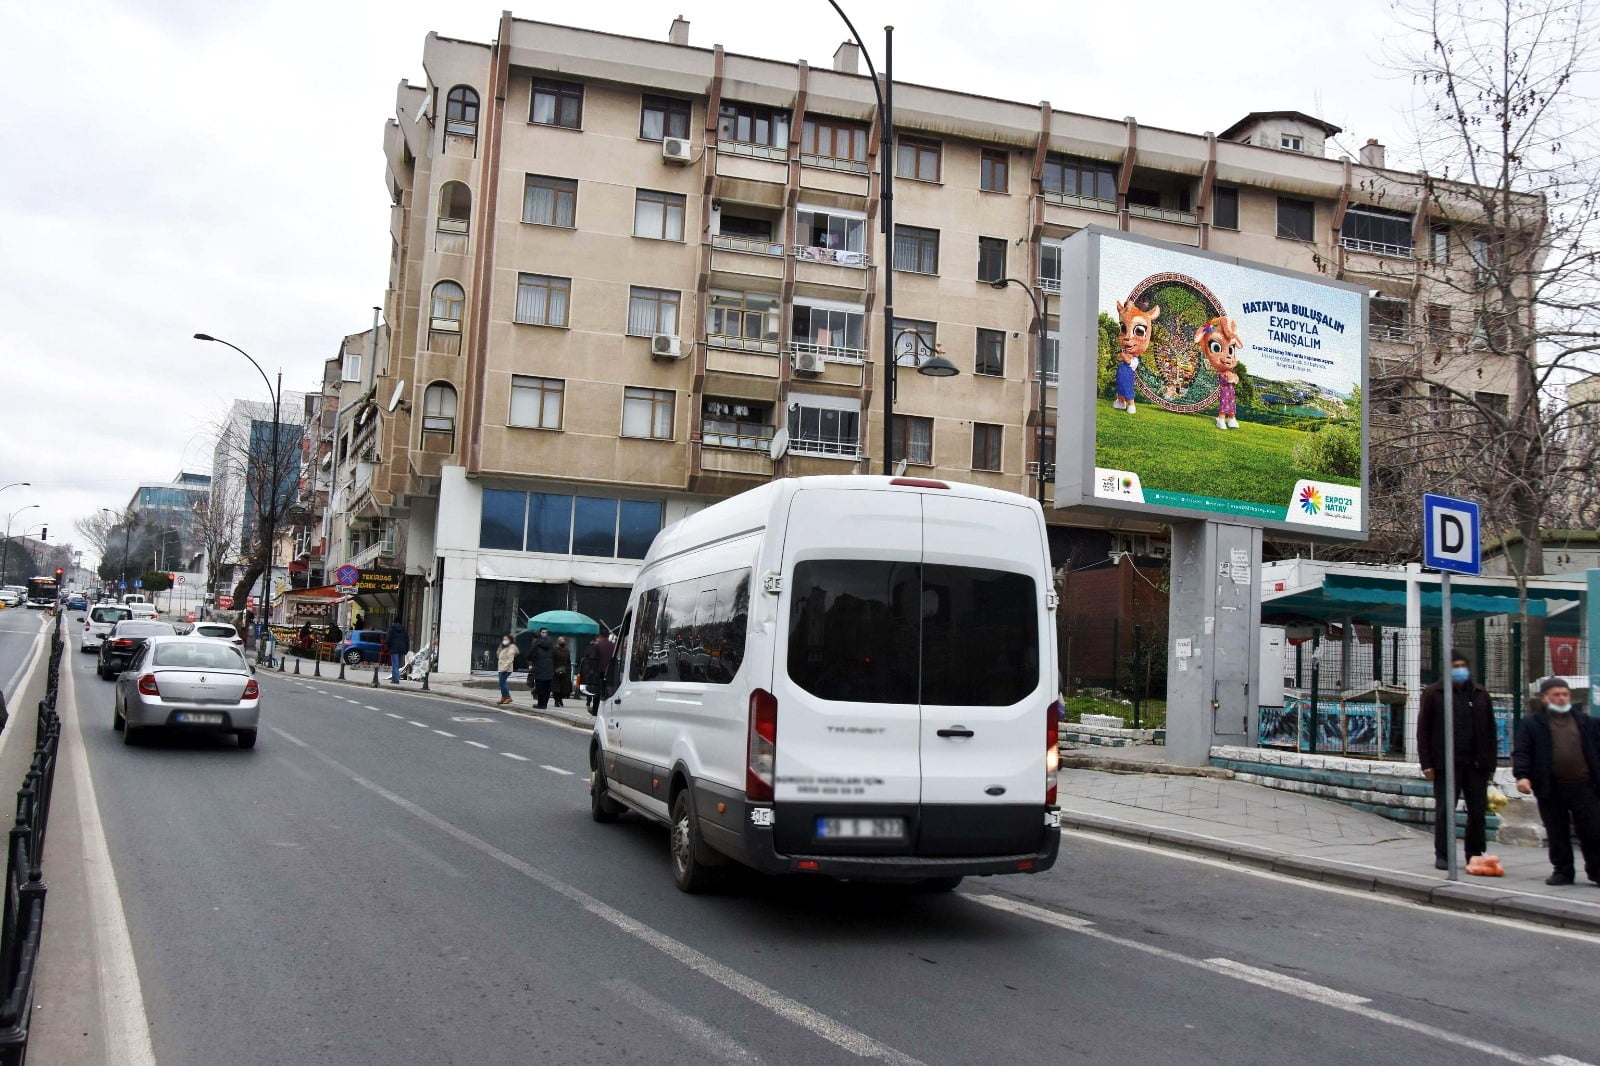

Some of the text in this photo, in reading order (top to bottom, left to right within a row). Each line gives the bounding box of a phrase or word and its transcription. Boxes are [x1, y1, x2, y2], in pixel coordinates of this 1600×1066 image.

[1243, 301, 1345, 334] HATAY'DA BULUŞALIM
[1270, 316, 1319, 335] EXPO'YLA
[1268, 329, 1321, 349] TANIŞALIM
[1325, 495, 1352, 506] EXPO'21
[1325, 503, 1347, 513] HATAY
[1440, 514, 1464, 553] D
